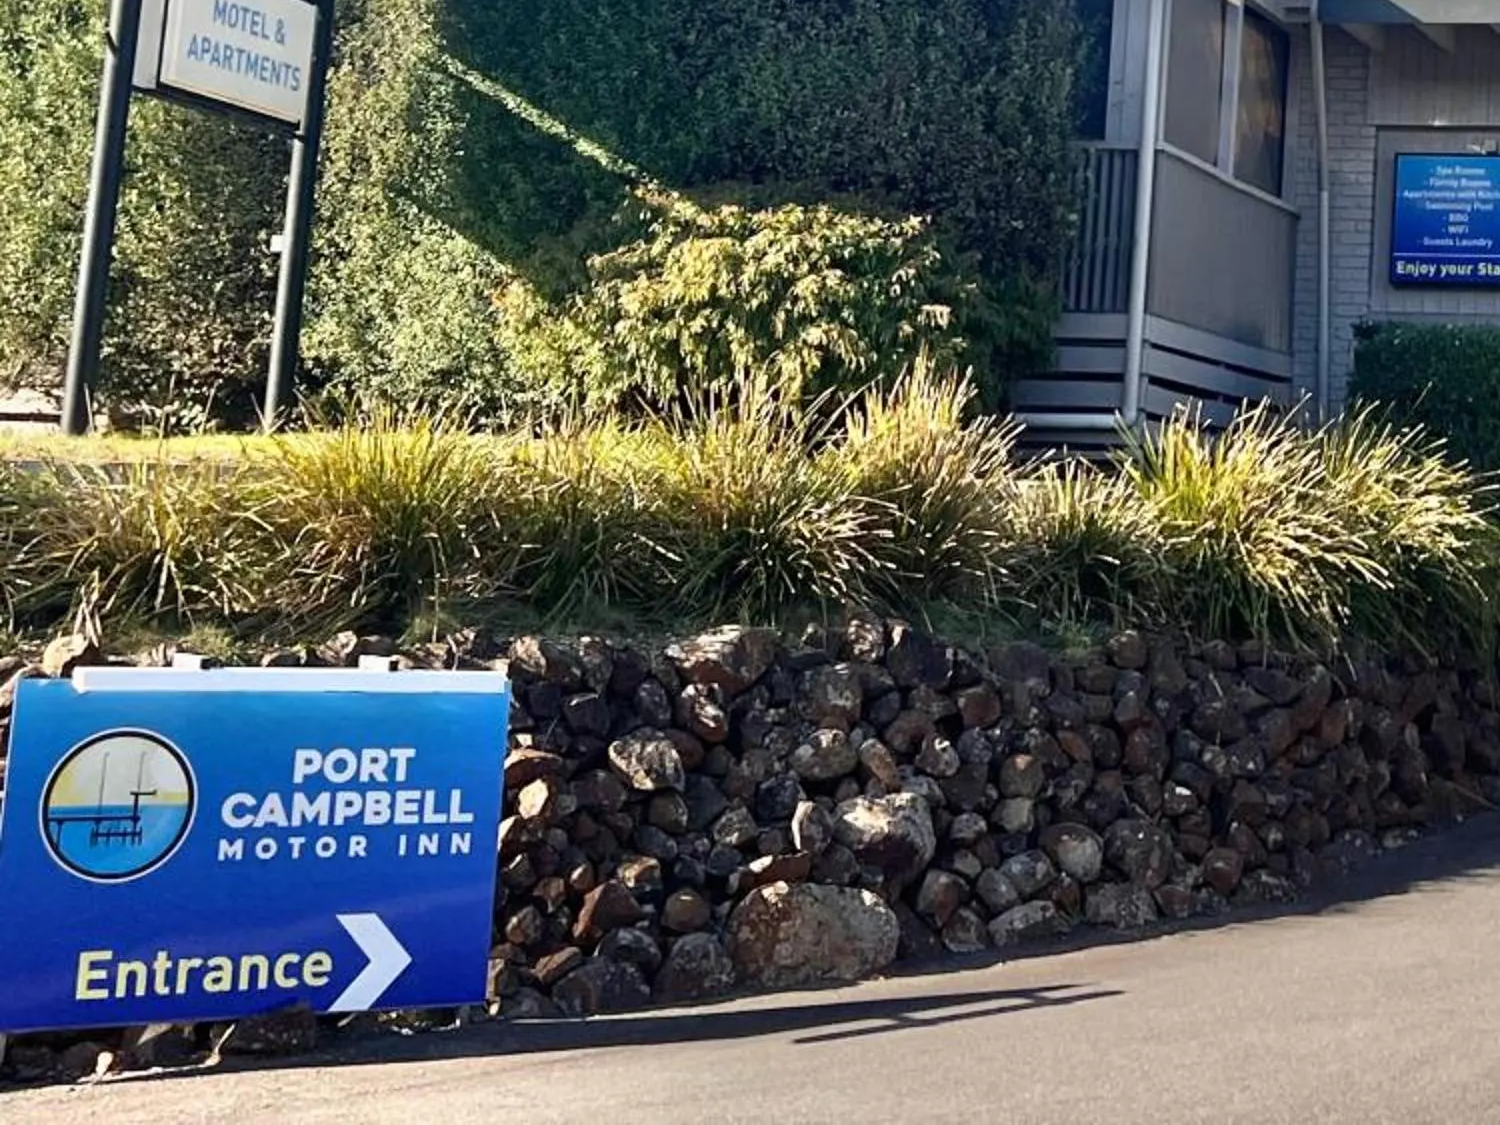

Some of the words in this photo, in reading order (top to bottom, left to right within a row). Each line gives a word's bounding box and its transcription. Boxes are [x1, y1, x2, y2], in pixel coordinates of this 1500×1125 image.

[274, 18, 286, 46] &
[187, 33, 301, 92] APARTMENTS
[1396, 260, 1436, 277] Enjoy
[1440, 262, 1474, 277] your
[292, 748, 417, 784] PORT
[221, 789, 475, 829] CAMPBELL
[217, 837, 368, 862] MOTOR
[399, 832, 472, 856] INN
[75, 949, 334, 1001] Entrance
